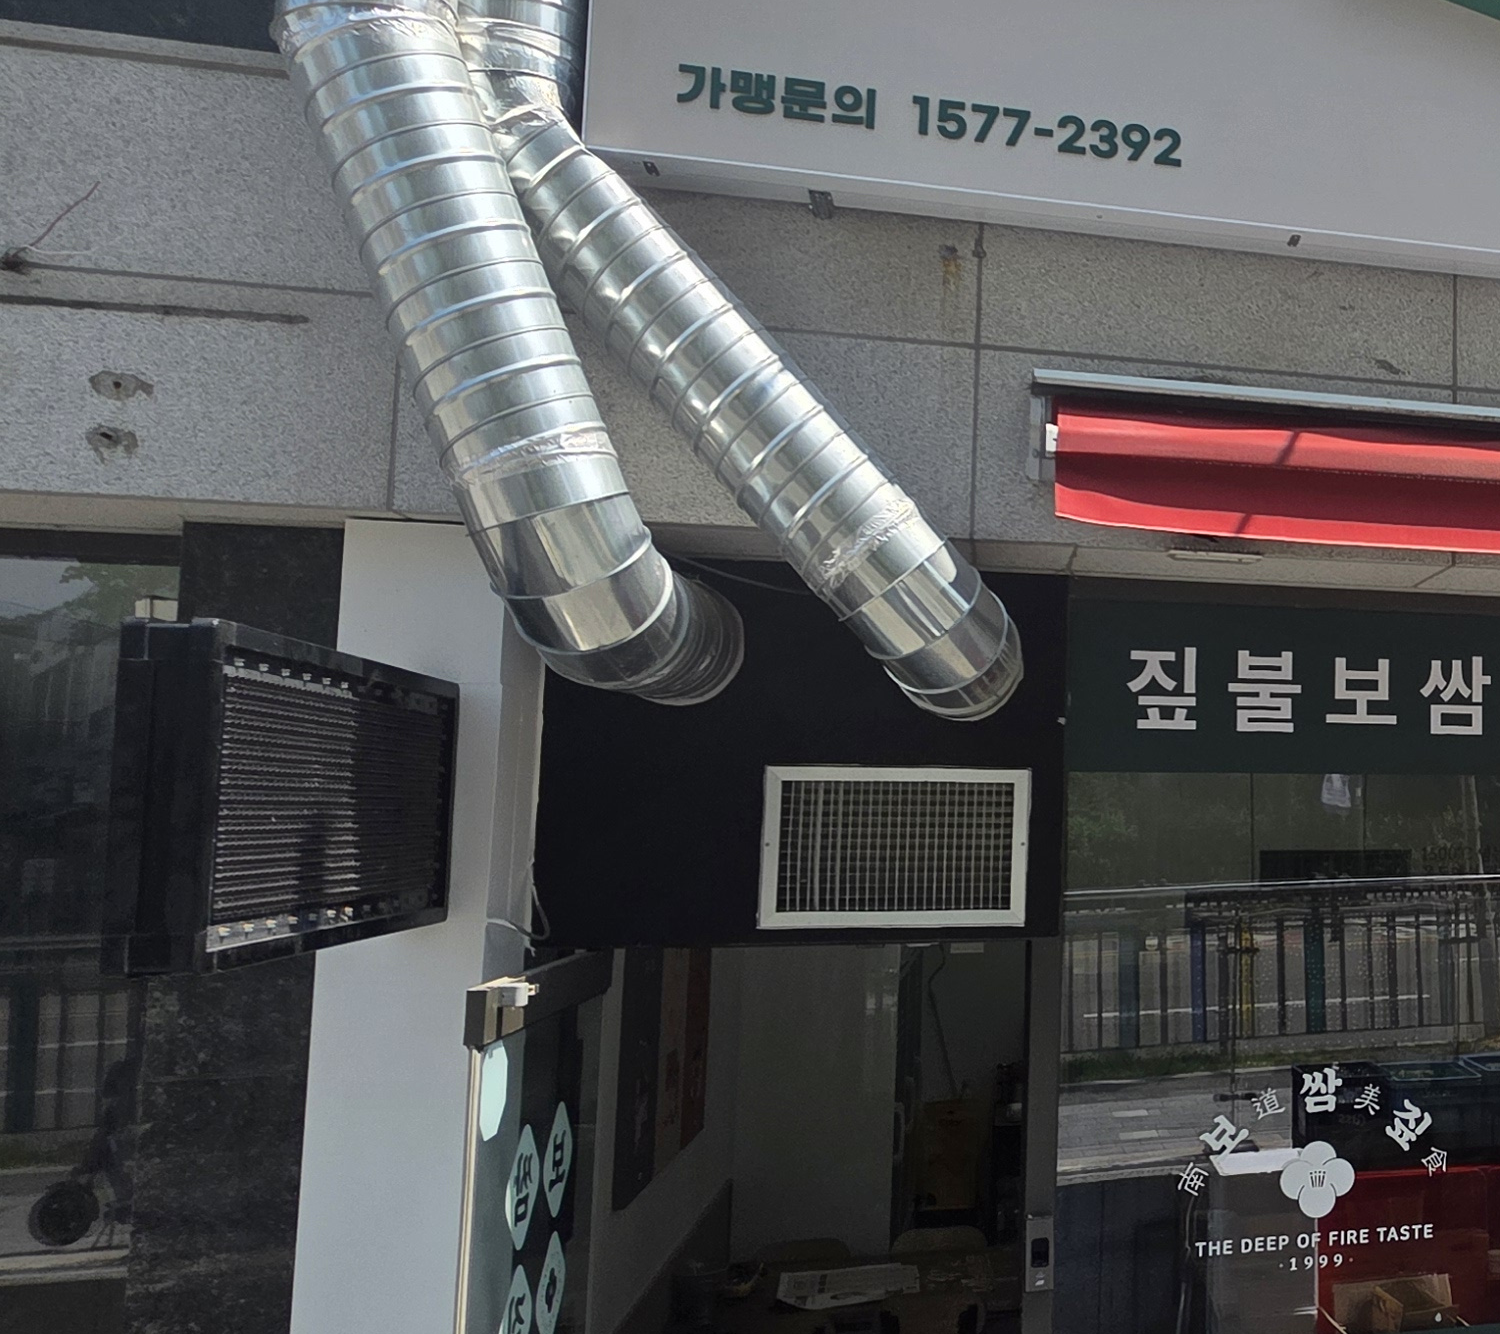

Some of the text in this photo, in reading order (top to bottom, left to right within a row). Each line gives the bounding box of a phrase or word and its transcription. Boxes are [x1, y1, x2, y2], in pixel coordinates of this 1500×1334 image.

[676, 63, 1184, 168] 가맹문의 1577-2392
[1126, 646, 1492, 735] 짚불보쌈
[1195, 1223, 1434, 1258] THE DEEP OF FIRE TASTE
[1289, 1253, 1344, 1271] 1999
